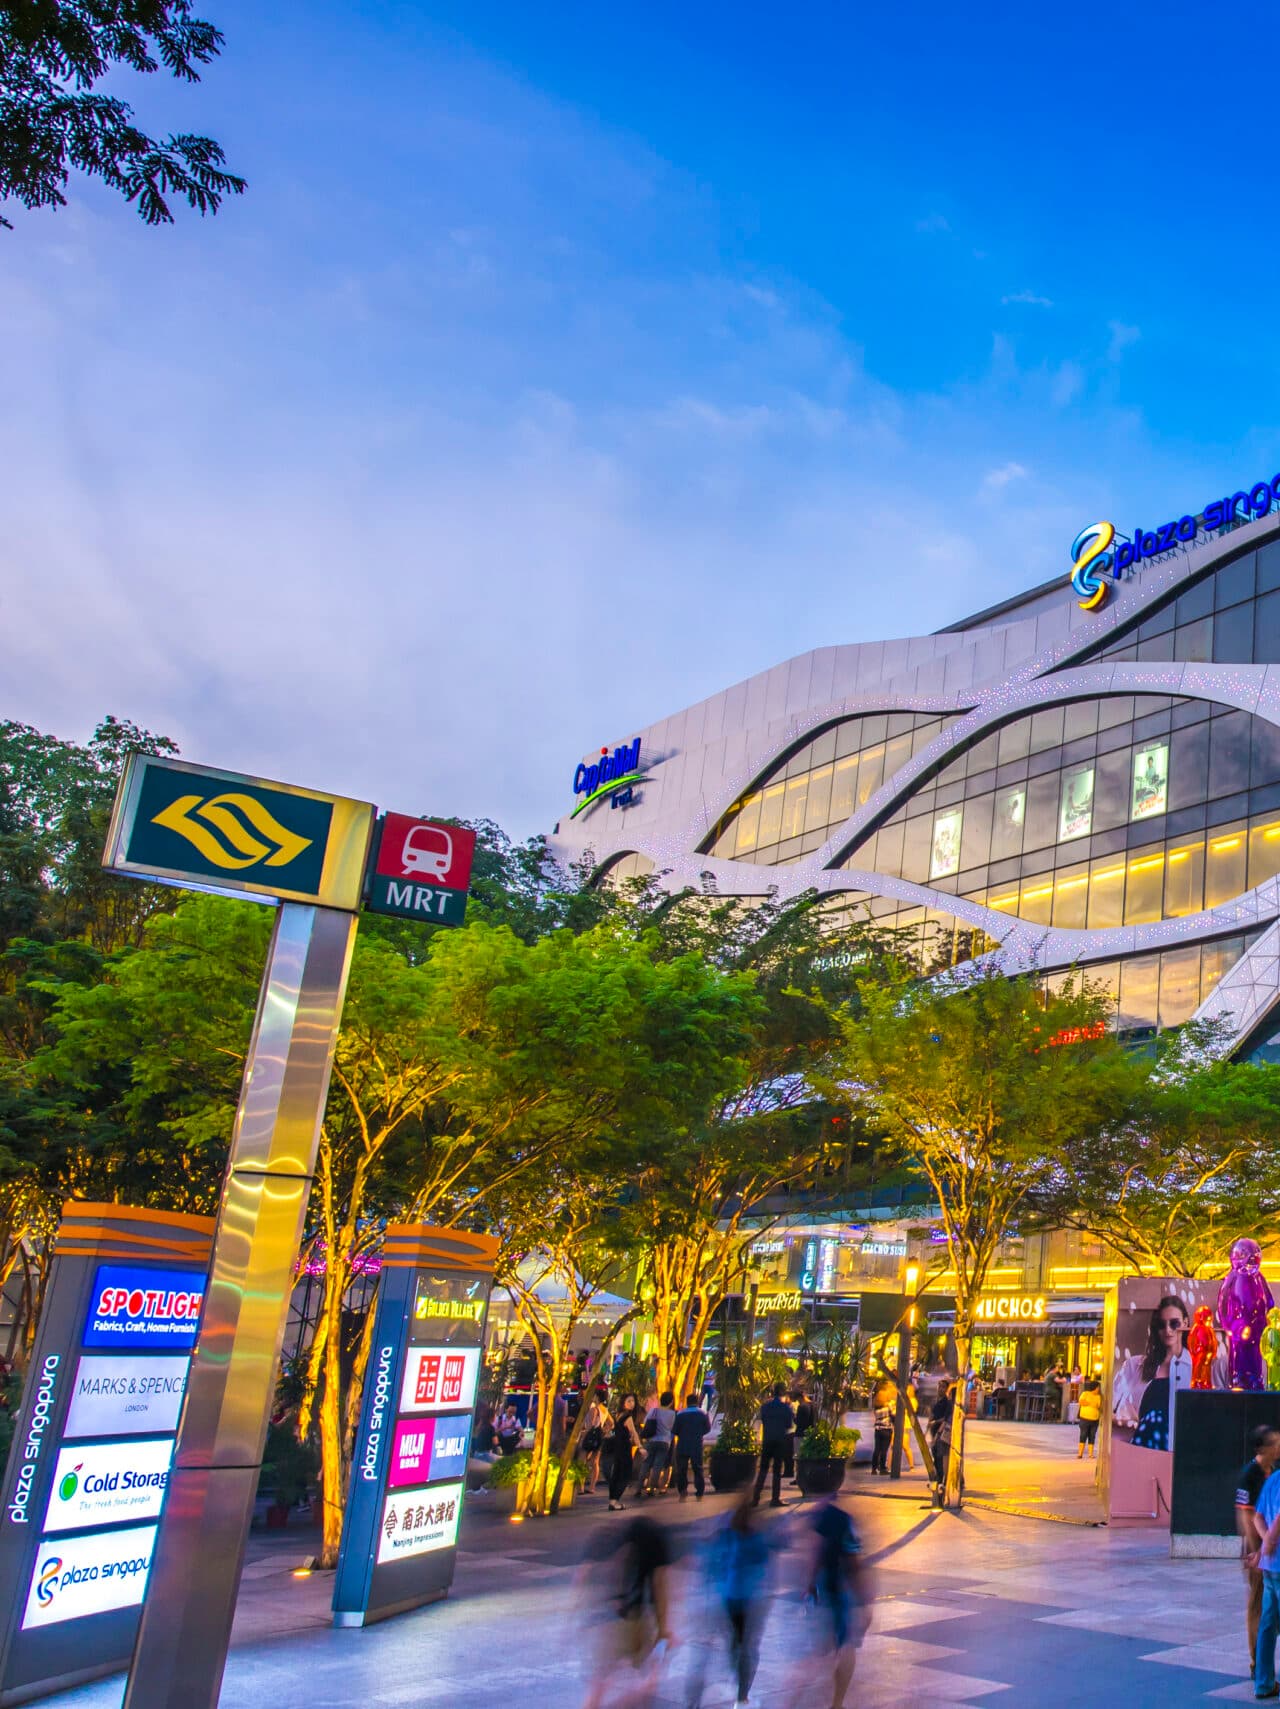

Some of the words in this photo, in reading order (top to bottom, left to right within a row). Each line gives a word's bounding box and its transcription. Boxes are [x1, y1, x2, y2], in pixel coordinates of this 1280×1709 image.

[1113, 515, 1197, 580] plaza
[385, 881, 453, 915] MRT
[96, 1287, 203, 1319] SPOTLIGH
[93, 1320, 125, 1333] Fabrics,
[125, 1321, 146, 1333] Craft,
[146, 1322, 169, 1333] Home
[169, 1322, 196, 1333] Furnish
[446, 1360, 462, 1378] UNI
[79, 1378, 127, 1395] MARKS
[128, 1378, 137, 1395] &
[138, 1377, 187, 1394] SPENCE
[443, 1380, 460, 1400] QLO
[361, 1433, 380, 1481] plaza
[371, 1346, 393, 1430] singapura
[8, 1464, 36, 1523] plaza
[25, 1355, 61, 1459] singapura
[399, 1433, 425, 1457] MUJI
[446, 1436, 465, 1456] MUJI
[83, 1472, 120, 1493] Cold
[121, 1471, 169, 1490] Storag
[393, 1537, 413, 1548] Nanjing
[414, 1531, 445, 1543] Impressions
[60, 1565, 99, 1592] plaza
[102, 1557, 151, 1580] singapu
